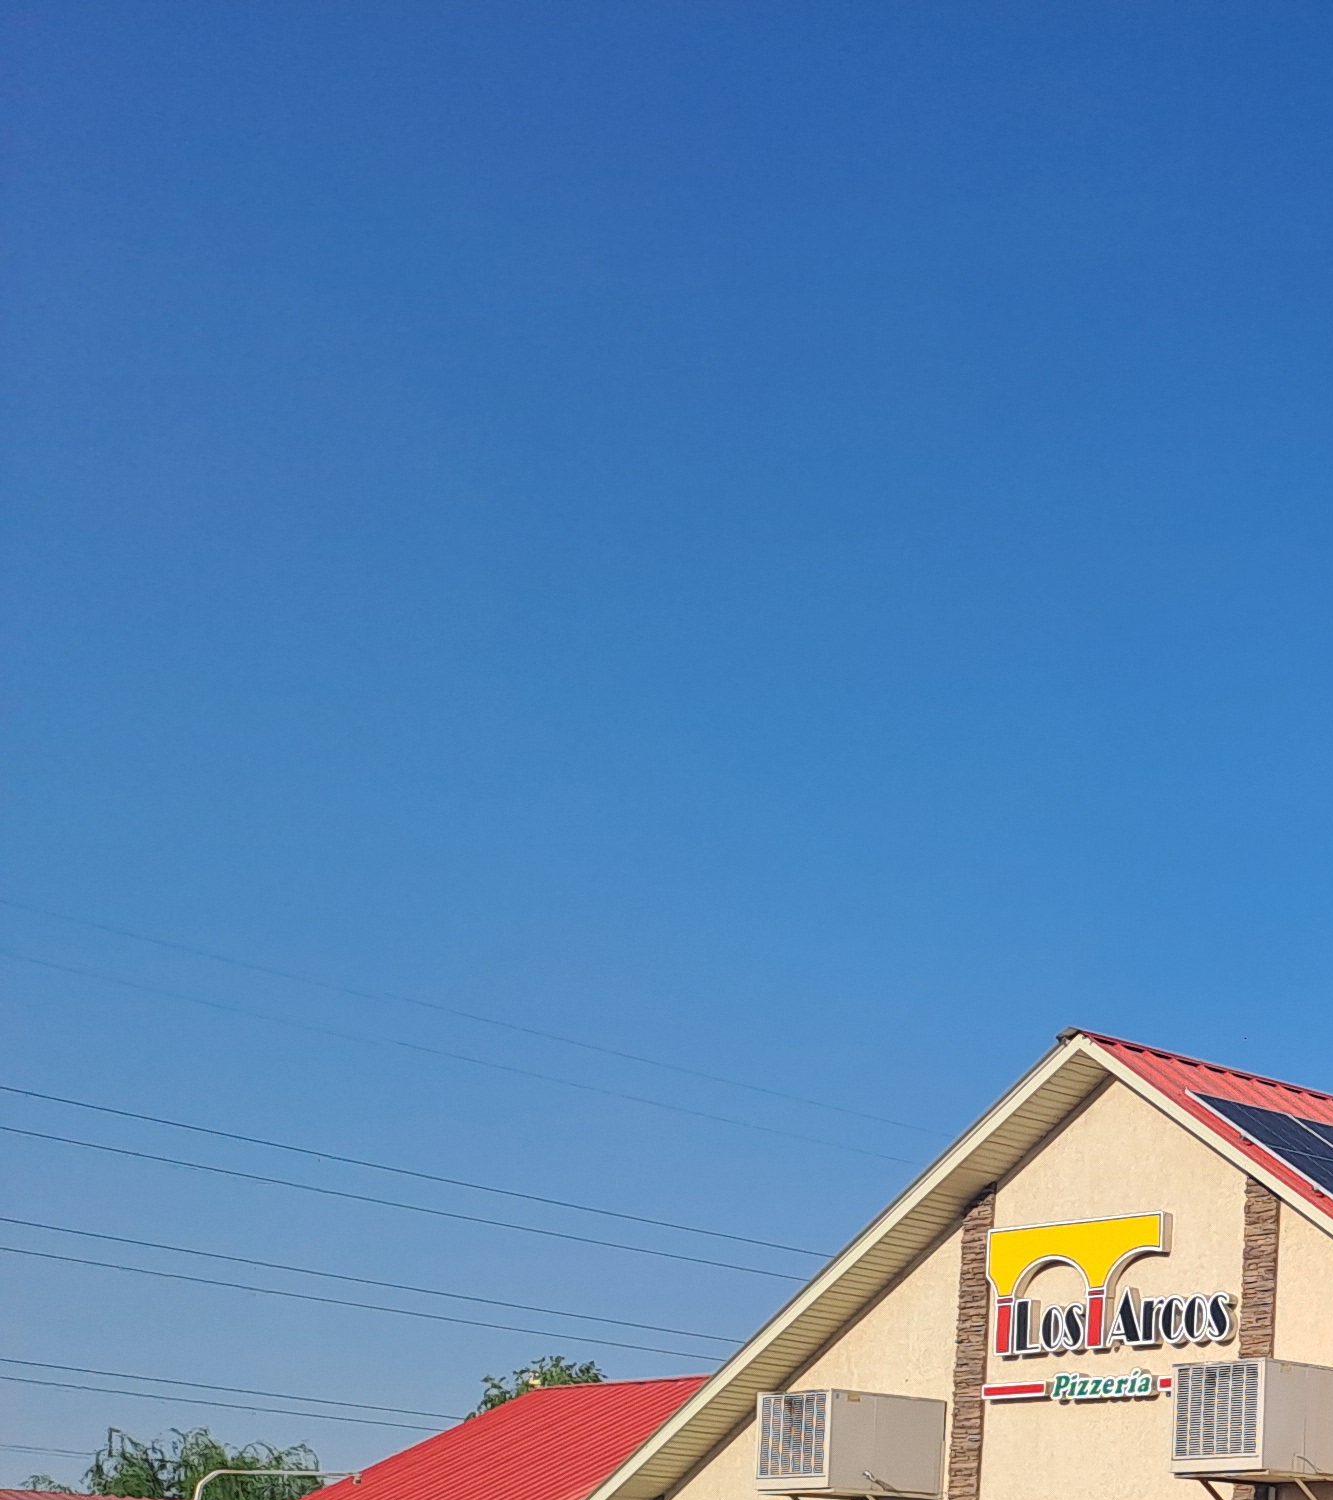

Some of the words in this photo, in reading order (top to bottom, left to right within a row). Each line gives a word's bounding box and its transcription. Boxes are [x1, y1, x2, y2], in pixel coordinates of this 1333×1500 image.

[1014, 1297, 1085, 1353] Los
[1107, 1286, 1231, 1345] Arcos
[1052, 1367, 1152, 1398] Pizzería
